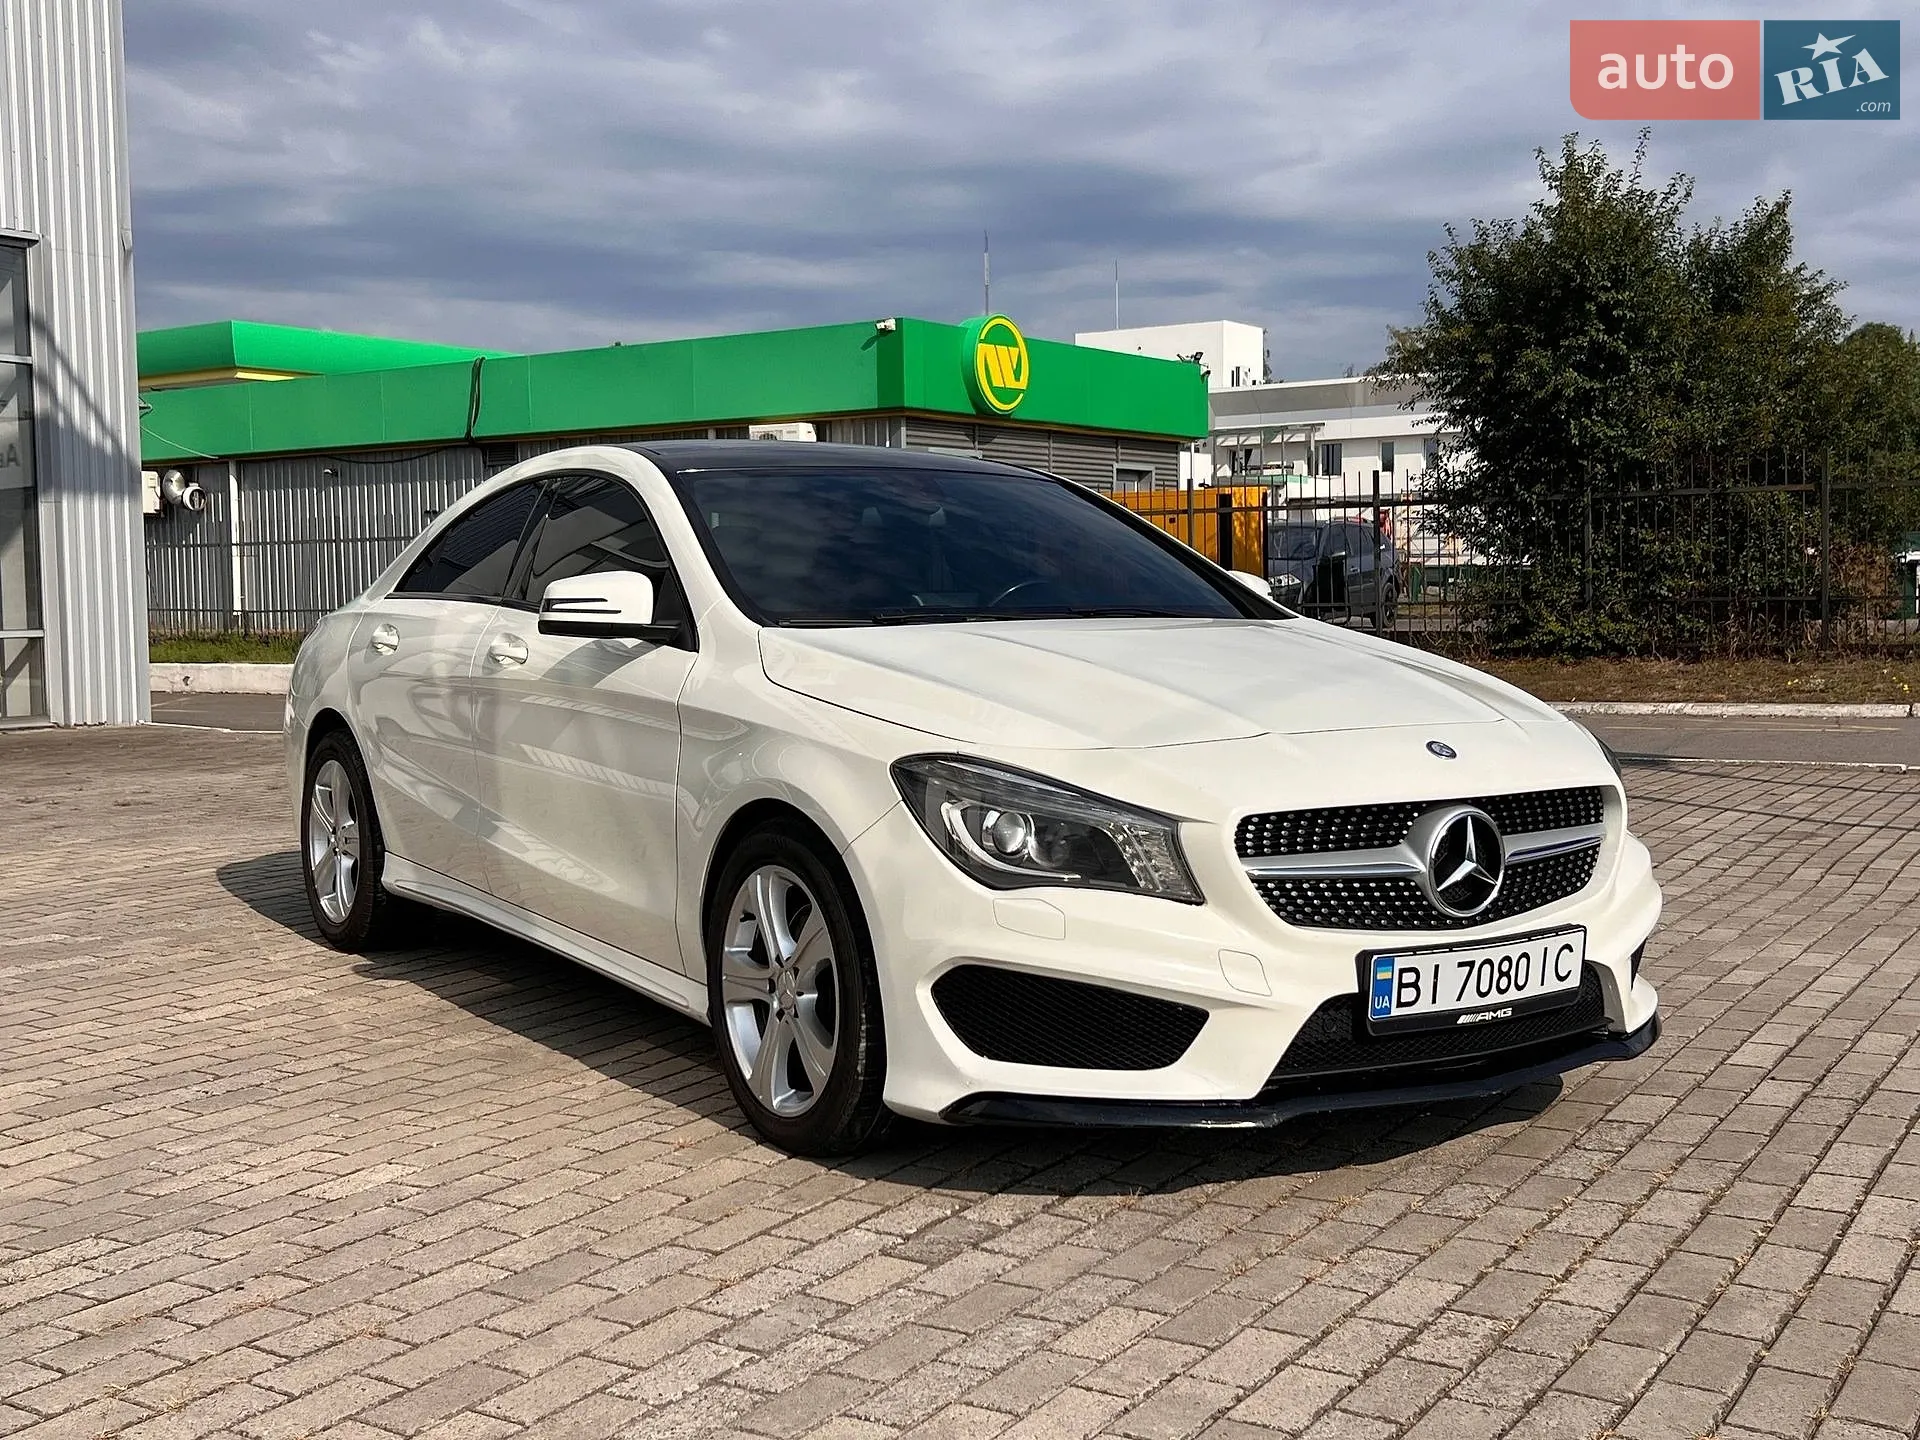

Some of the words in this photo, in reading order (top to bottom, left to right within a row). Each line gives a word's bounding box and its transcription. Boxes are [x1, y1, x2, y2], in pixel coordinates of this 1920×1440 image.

[1396, 964, 1440, 1009] BI
[1456, 951, 1531, 1002] 7080
[1540, 943, 1574, 987] IC
[1374, 996, 1390, 1009] UA
[1476, 1007, 1513, 1022] AMG
